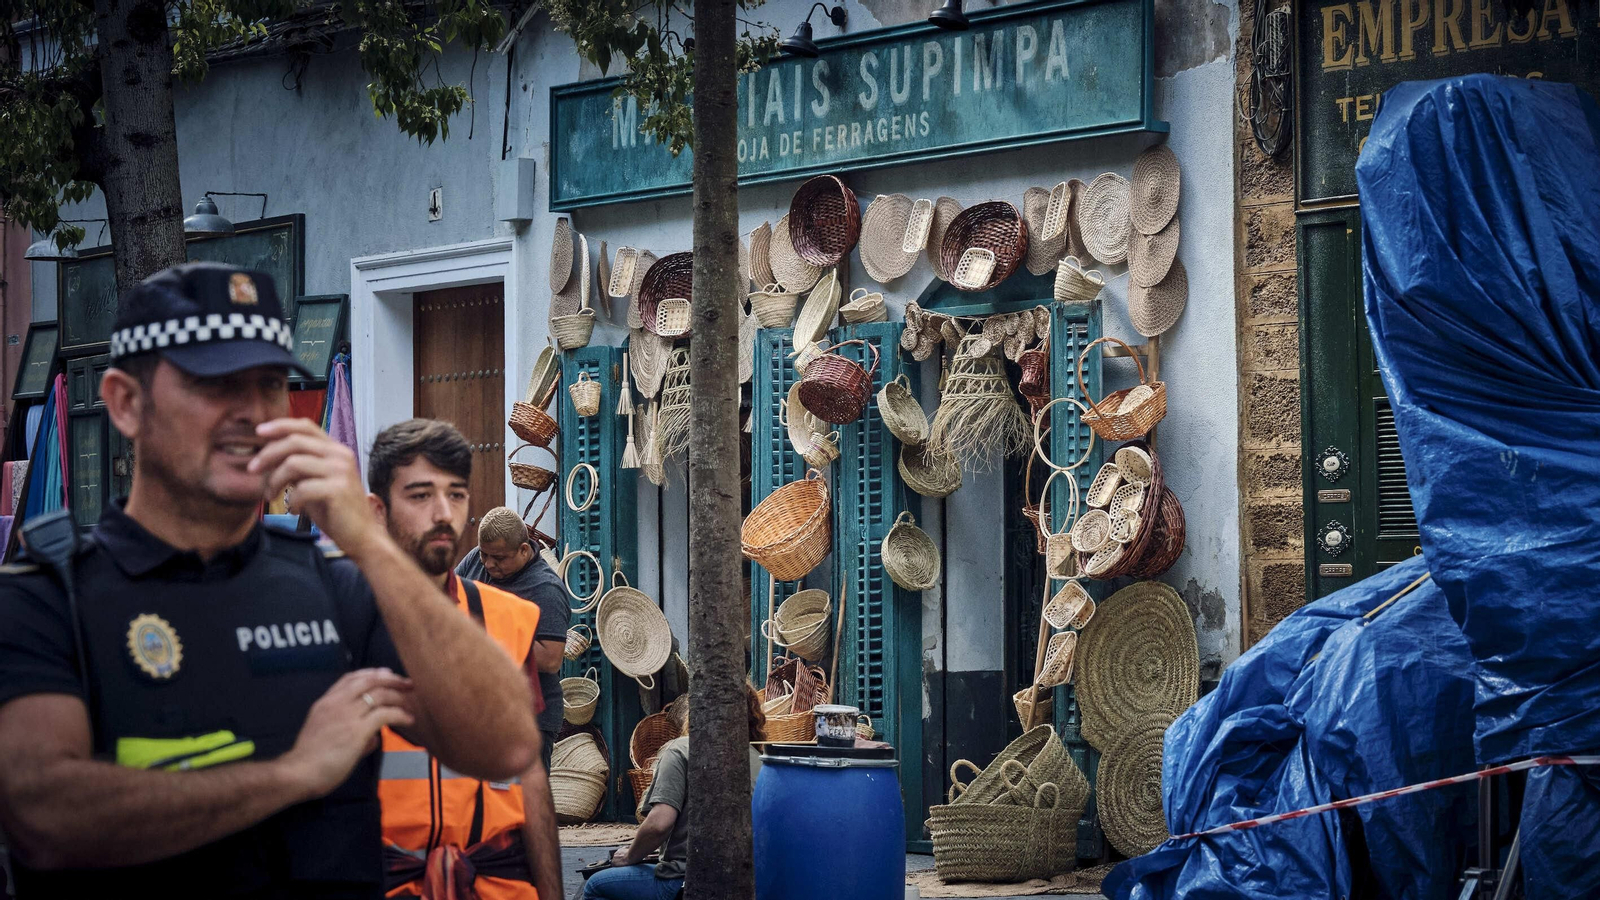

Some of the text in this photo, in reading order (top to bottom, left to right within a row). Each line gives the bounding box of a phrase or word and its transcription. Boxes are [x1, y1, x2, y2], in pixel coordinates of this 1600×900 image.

[612, 19, 1069, 150] MIAIS SUPIMPA
[737, 111, 930, 163] OJA DE FERRAGENS
[236, 619, 340, 652] POLICIA
